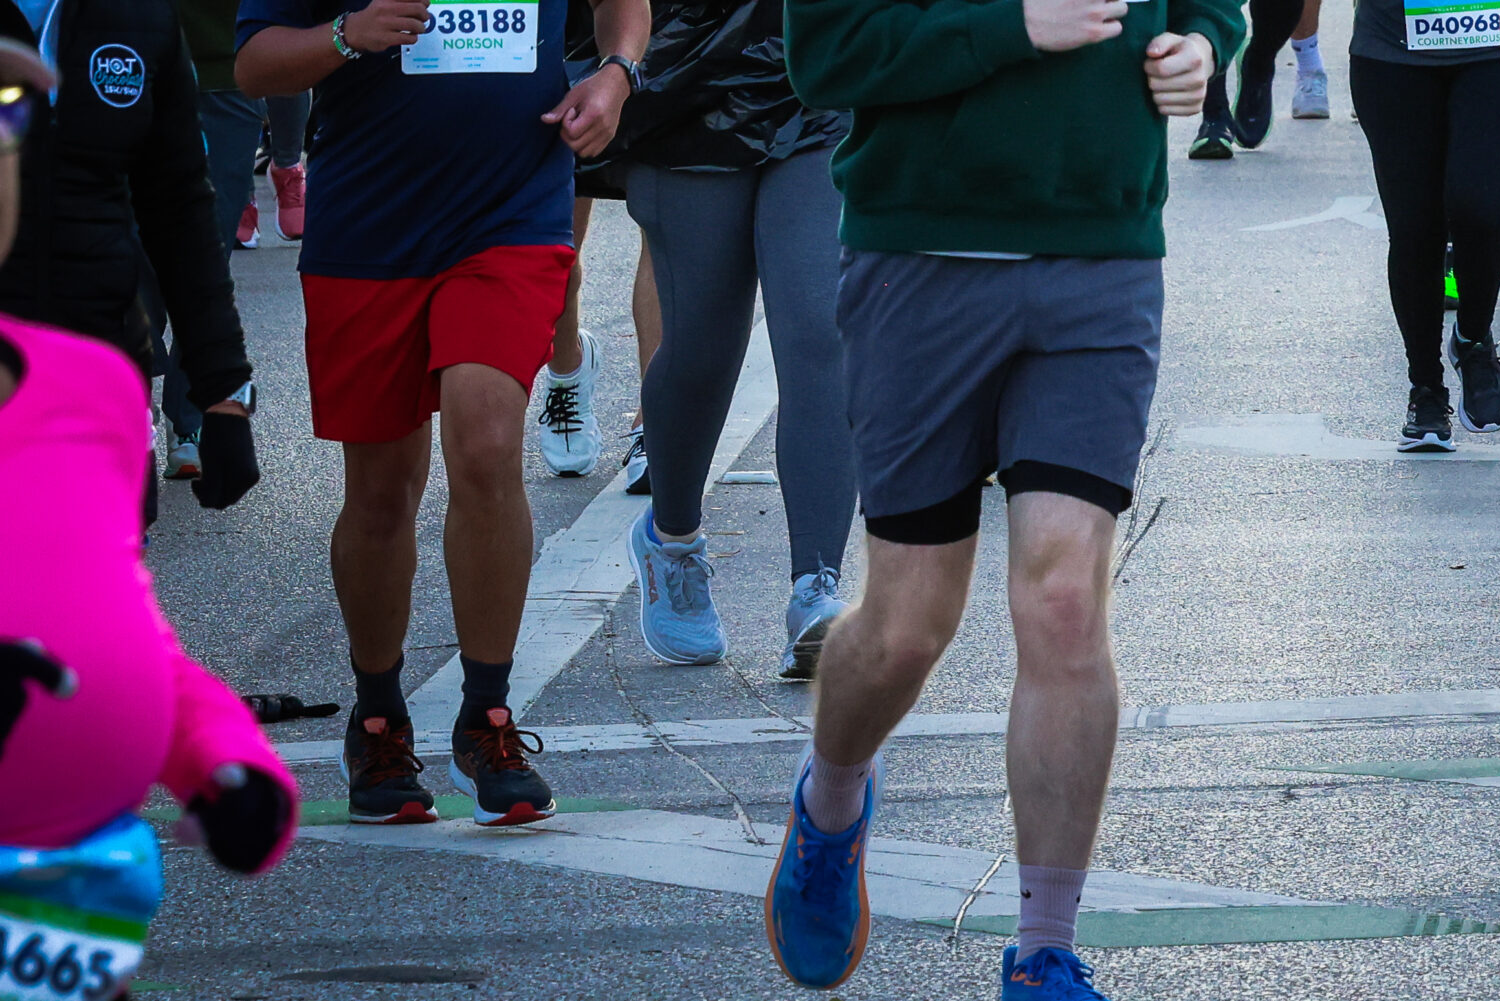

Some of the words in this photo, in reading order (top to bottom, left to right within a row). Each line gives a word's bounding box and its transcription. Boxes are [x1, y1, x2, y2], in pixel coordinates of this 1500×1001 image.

[1415, 13, 1500, 35] D40968
[443, 38, 504, 50] NORSON
[97, 57, 137, 75] HOT
[0, 925, 115, 1000] 665
